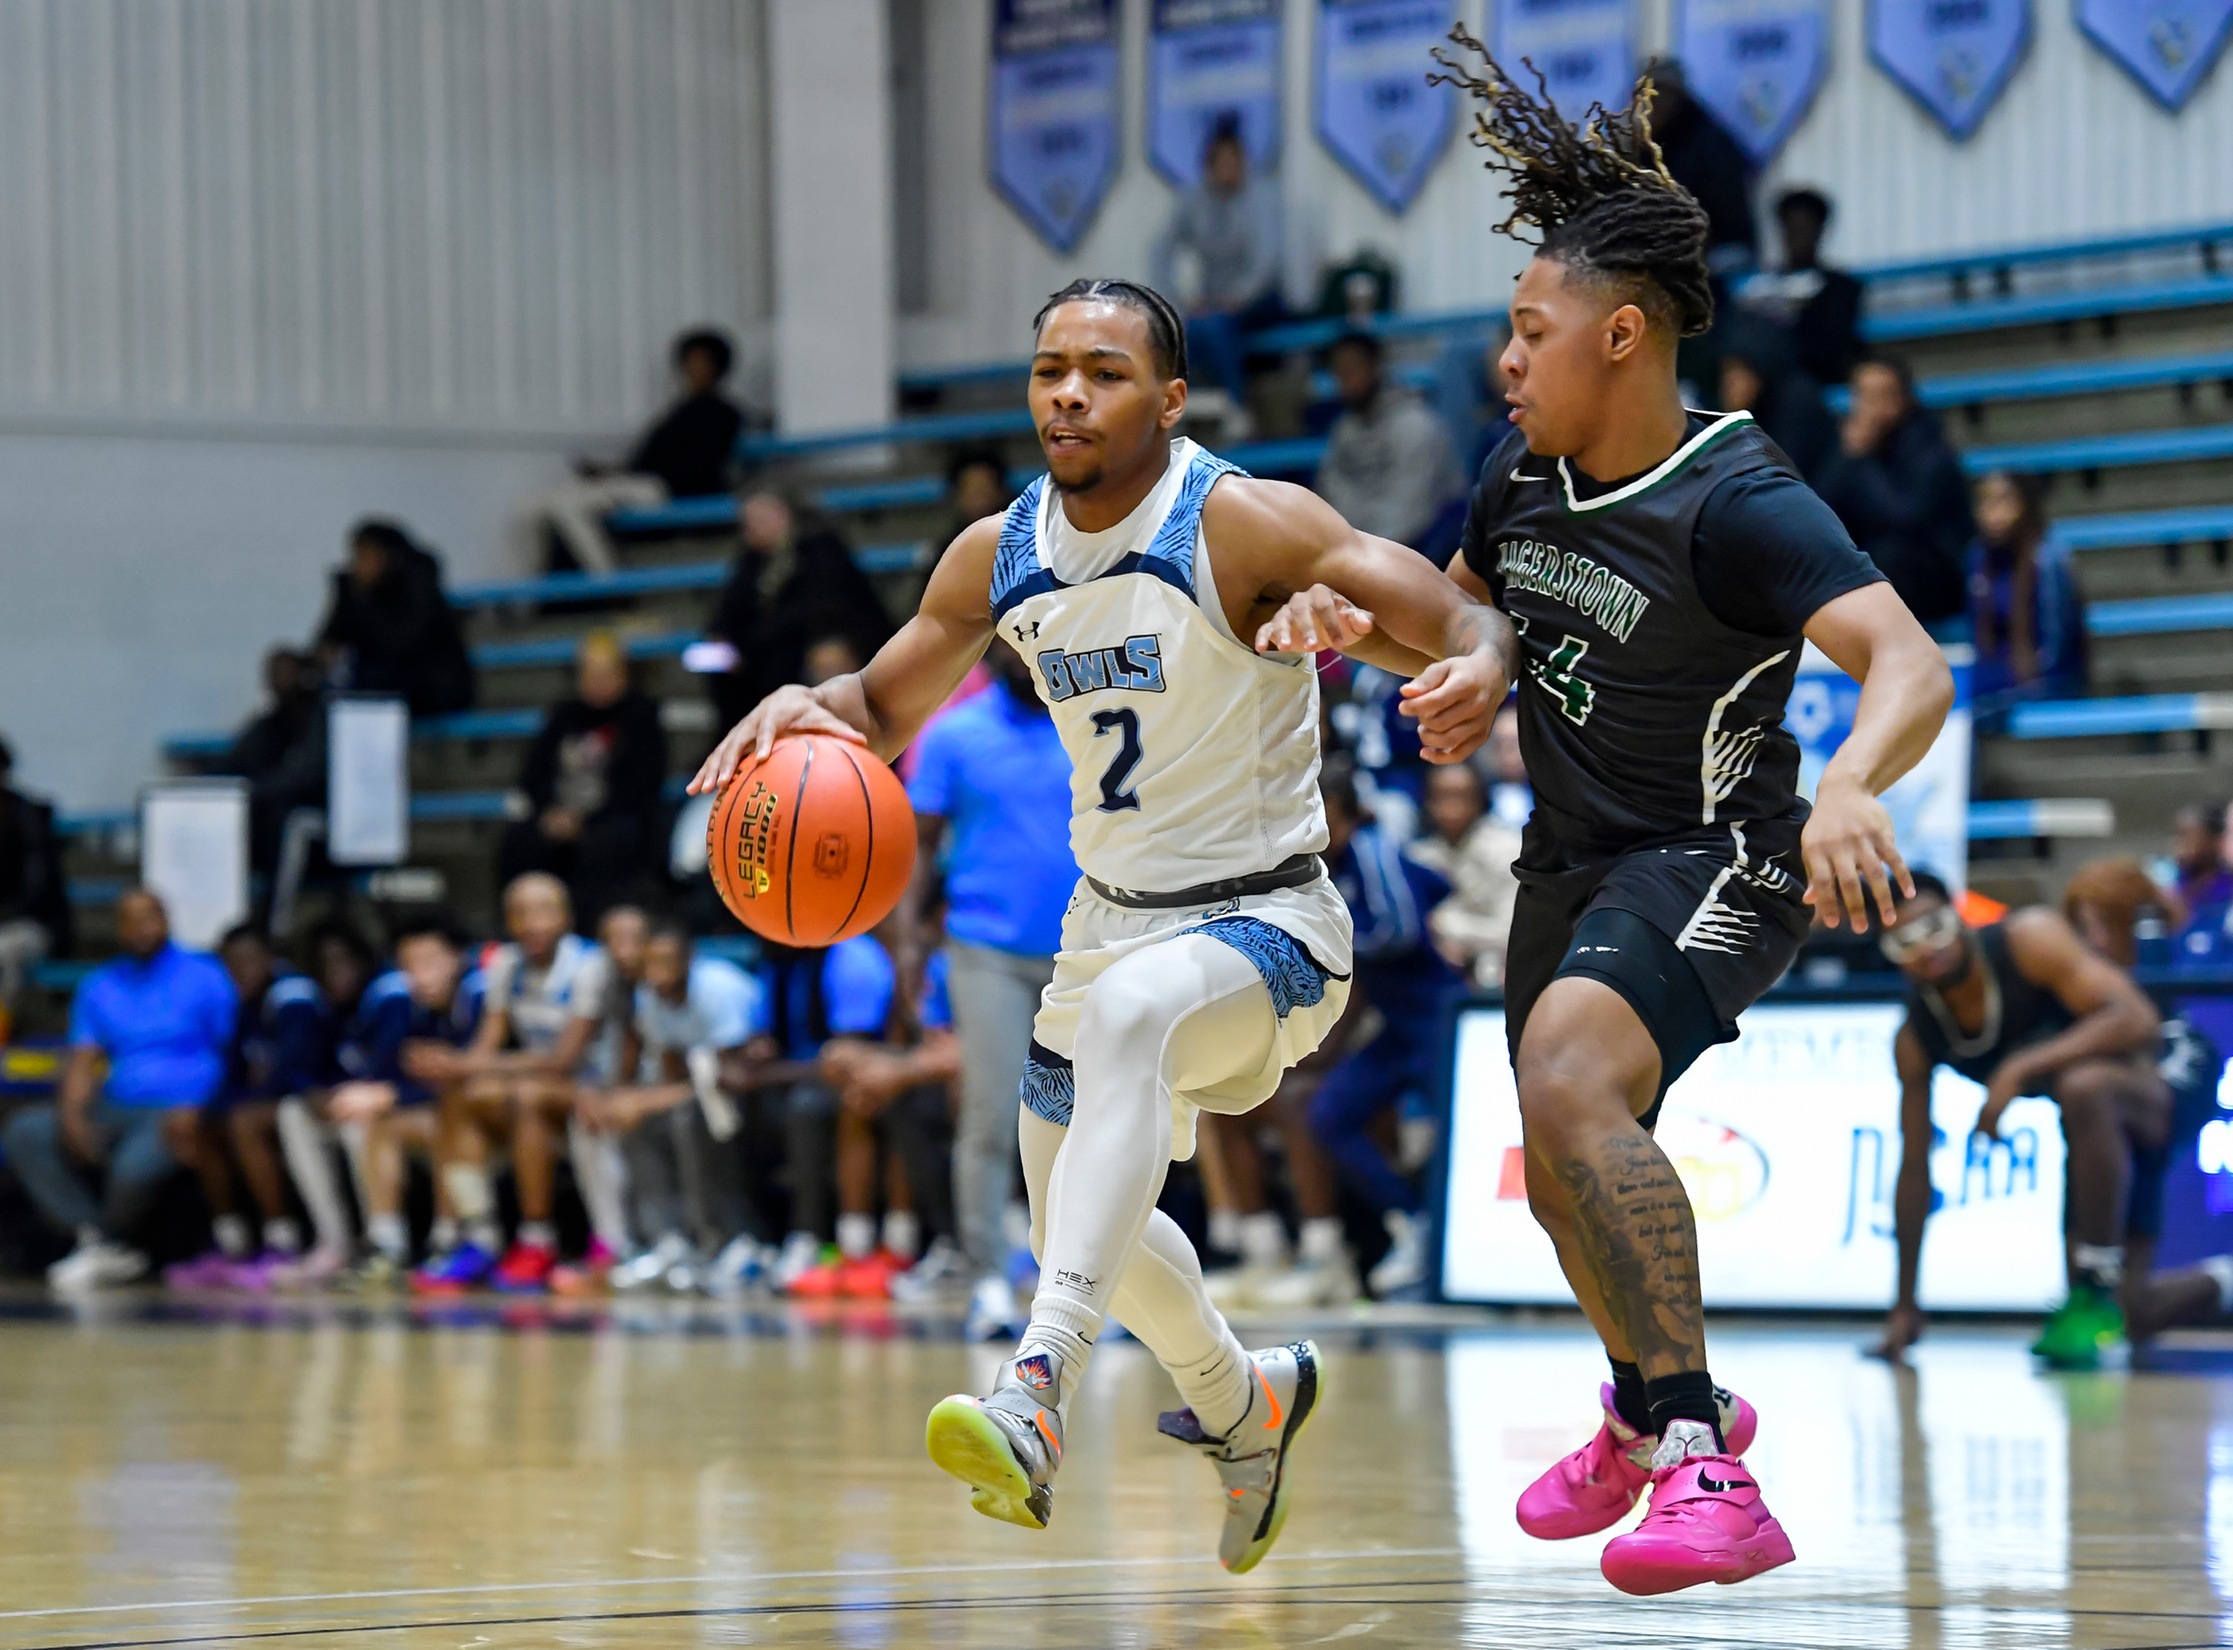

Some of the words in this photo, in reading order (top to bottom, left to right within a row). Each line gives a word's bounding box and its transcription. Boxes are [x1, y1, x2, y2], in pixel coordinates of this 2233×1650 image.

[1037, 633, 1166, 703] OWLS
[1509, 611, 1596, 727] 4
[1089, 706, 1143, 814] 2
[737, 780, 767, 900] LEGACY
[755, 793, 779, 867] 1000
[1056, 1268, 1097, 1289] HEX
